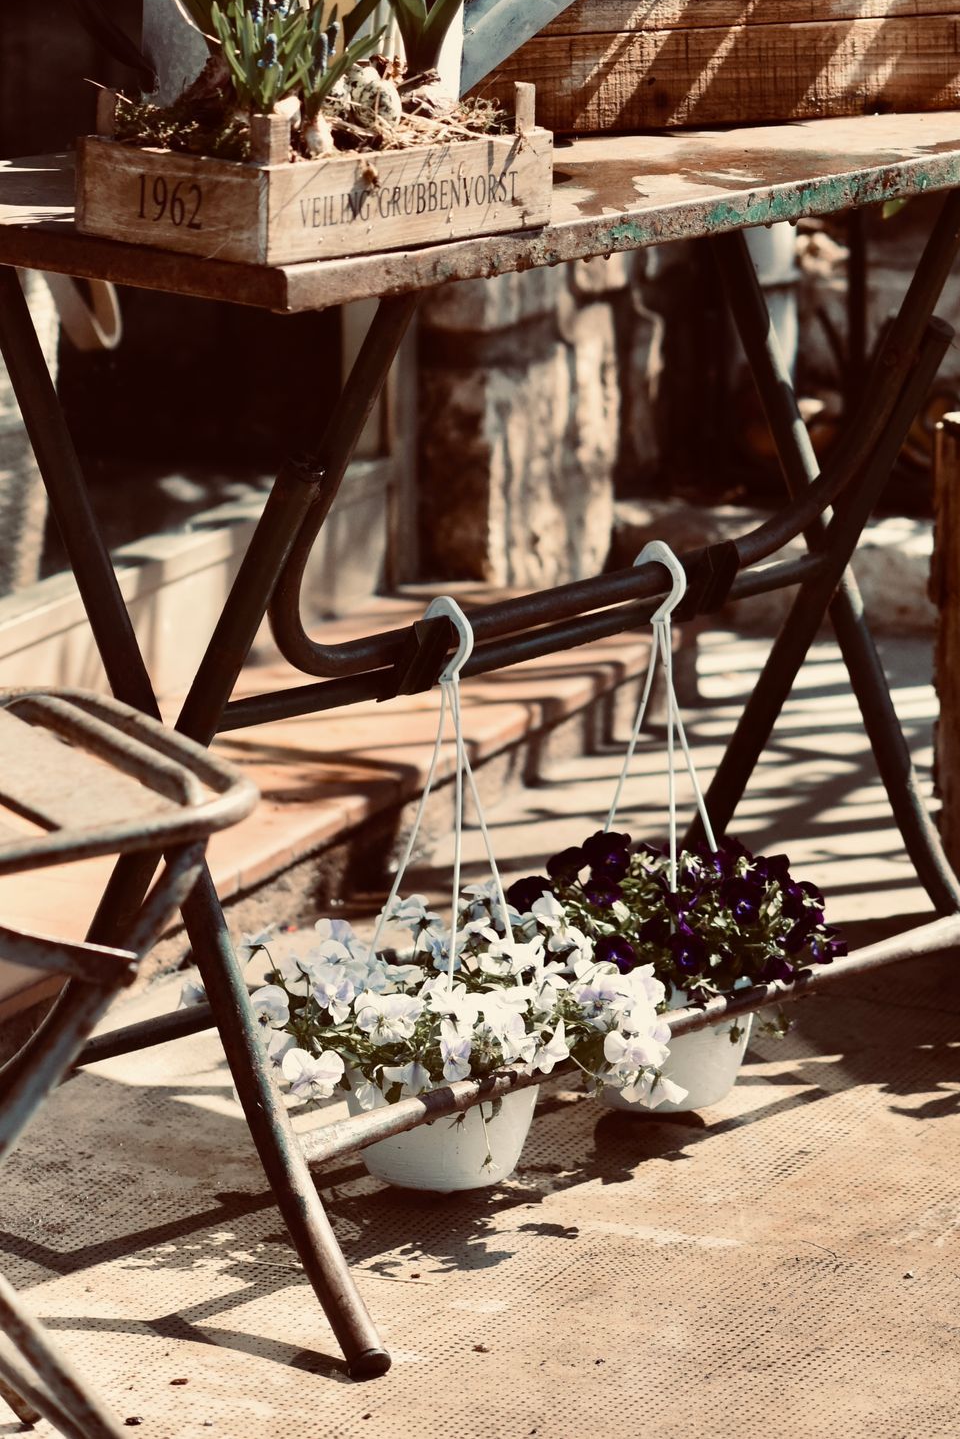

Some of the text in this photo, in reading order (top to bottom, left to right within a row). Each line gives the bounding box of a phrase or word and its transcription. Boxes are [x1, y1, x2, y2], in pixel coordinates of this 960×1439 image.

[138, 174, 202, 230] 1962
[300, 170, 519, 228] VEILING GRUBBENVORST
